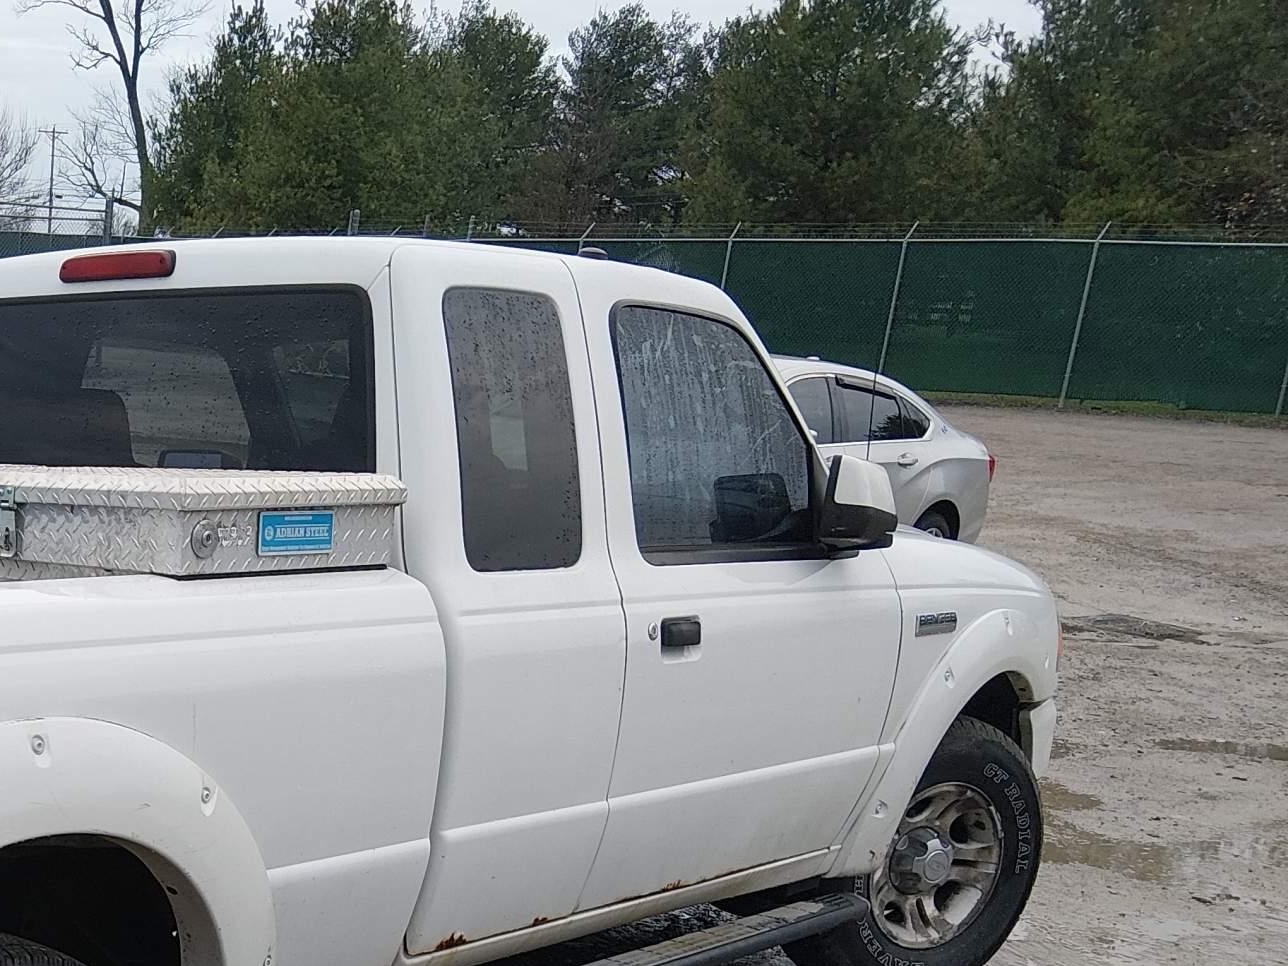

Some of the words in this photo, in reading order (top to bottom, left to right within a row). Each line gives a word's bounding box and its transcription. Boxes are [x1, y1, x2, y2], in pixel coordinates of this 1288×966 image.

[275, 527, 305, 538] ADRIAN
[305, 526, 329, 537] STEEL
[1004, 782, 1031, 874] RADIAL
